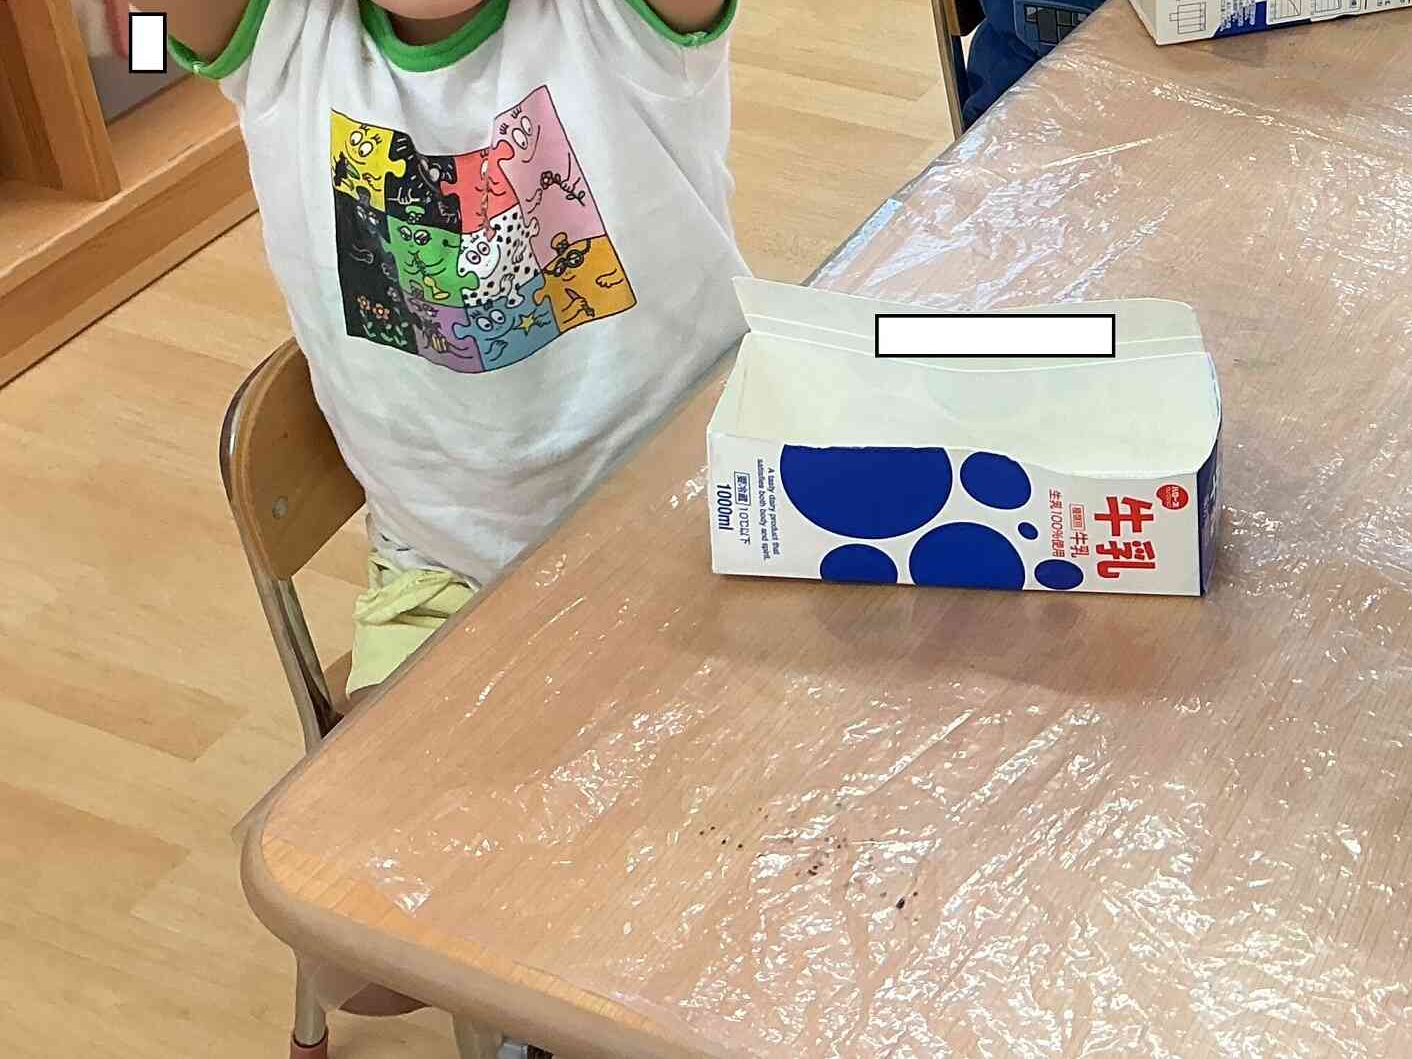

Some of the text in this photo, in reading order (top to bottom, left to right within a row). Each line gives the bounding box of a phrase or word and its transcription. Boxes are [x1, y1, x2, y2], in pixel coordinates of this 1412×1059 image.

[717, 484, 734, 531] 1000ml
[1049, 488, 1065, 558] 生乳100%使用
[1070, 532, 1090, 558] 牛乳
[1094, 496, 1156, 579] 牛乳
